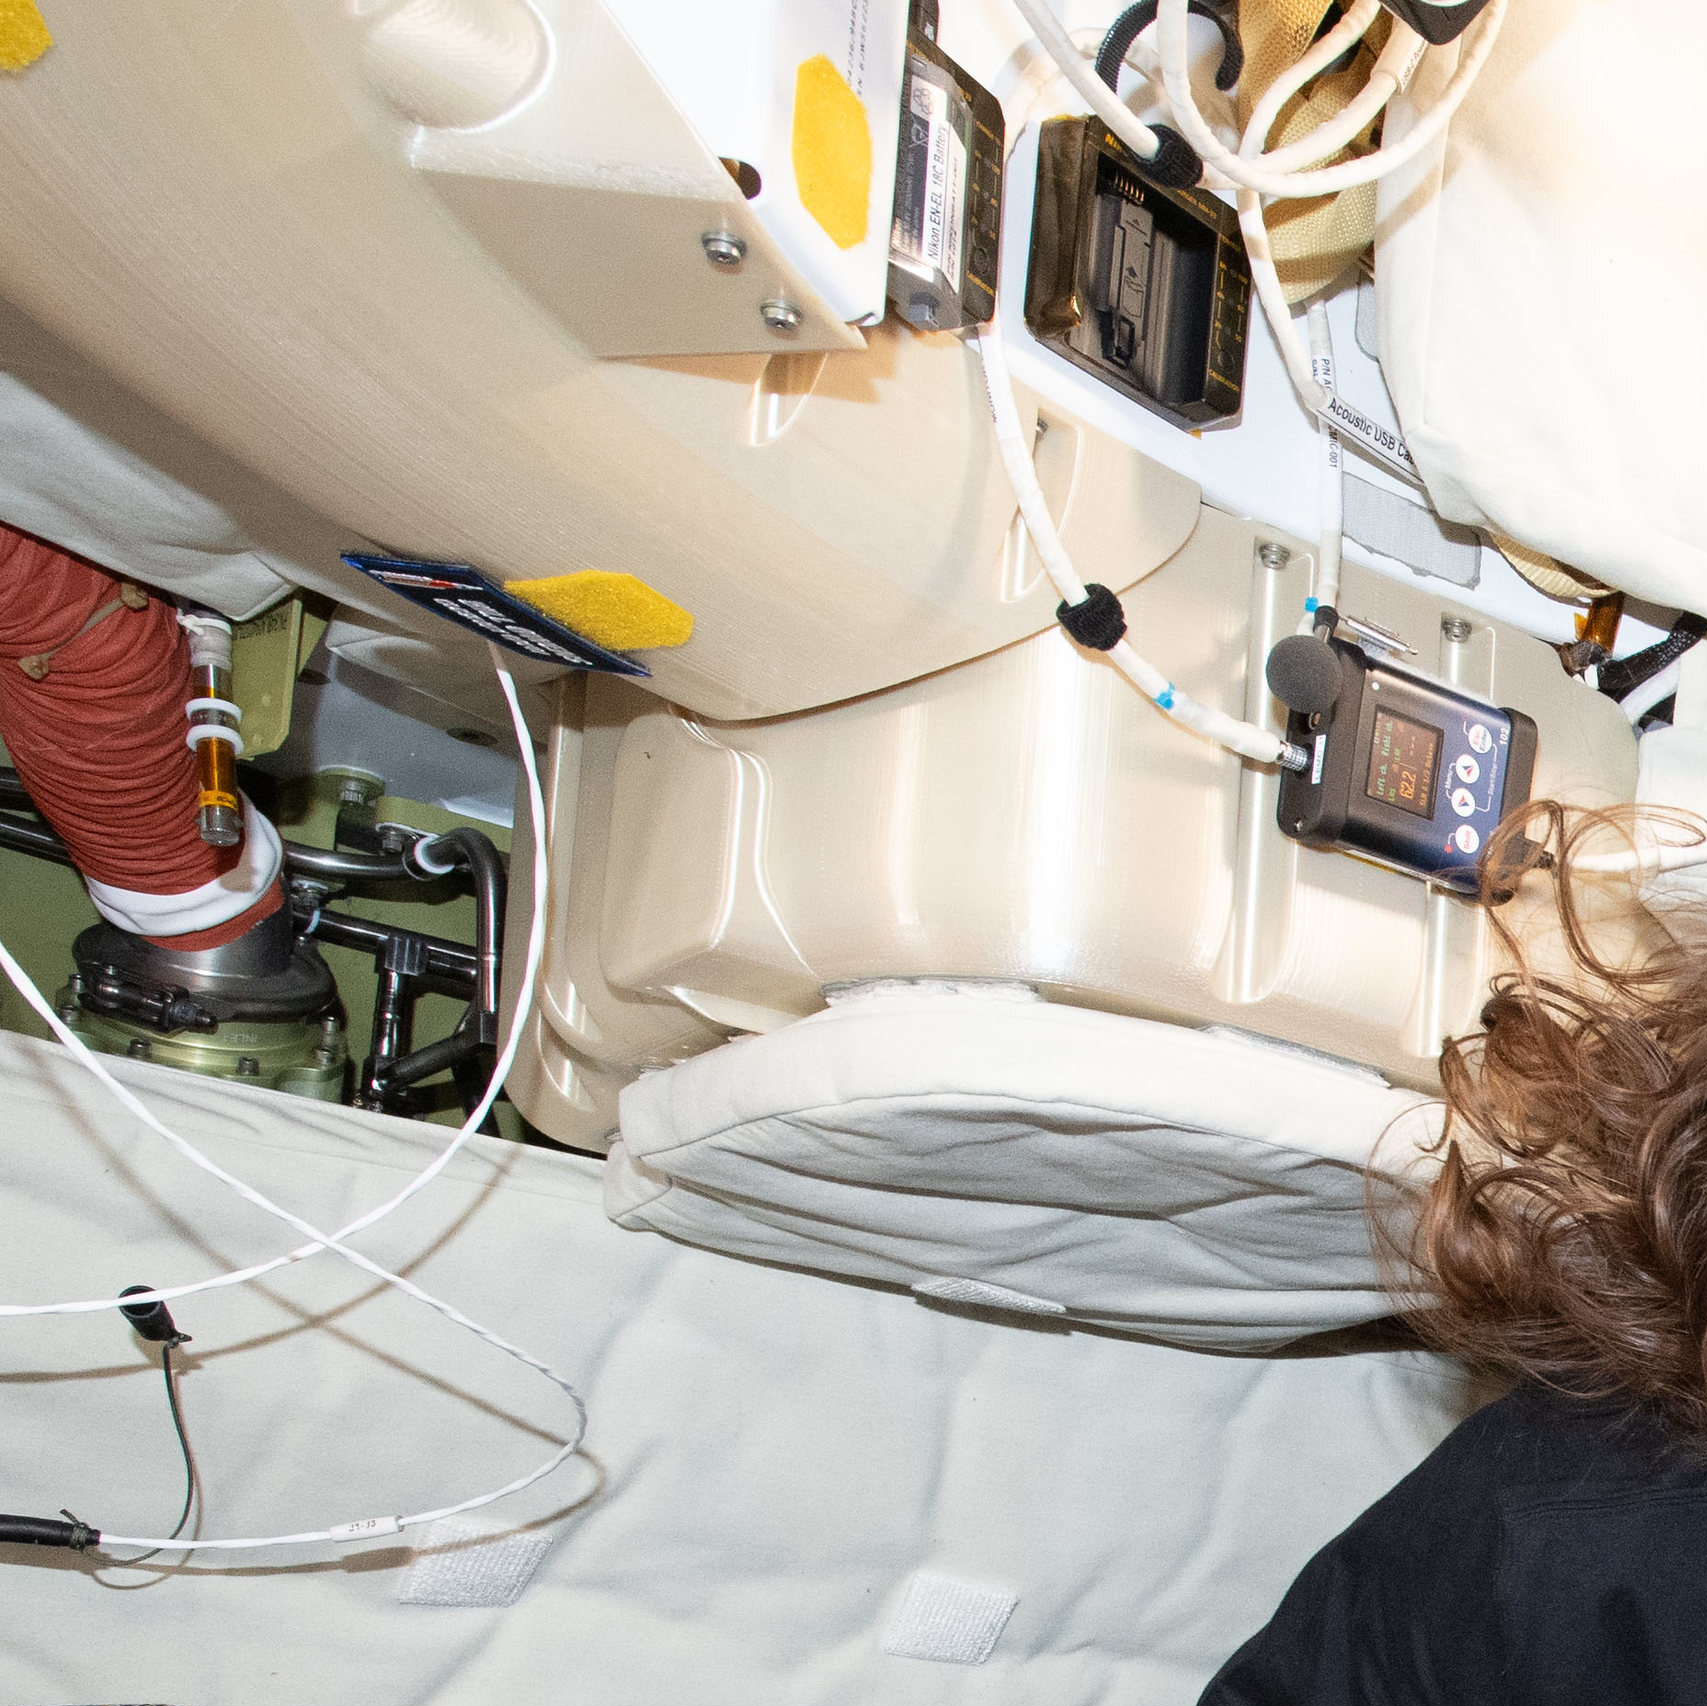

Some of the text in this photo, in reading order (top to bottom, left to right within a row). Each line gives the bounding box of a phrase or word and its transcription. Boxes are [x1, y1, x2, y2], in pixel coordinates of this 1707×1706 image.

[929, 192, 943, 225] EN-EL
[927, 227, 942, 261] Nikon
[1328, 398, 1373, 436] Acoustic
[1374, 425, 1396, 452] USB
[1500, 727, 1511, 745] 102
[1399, 770, 1417, 799] 62.2
